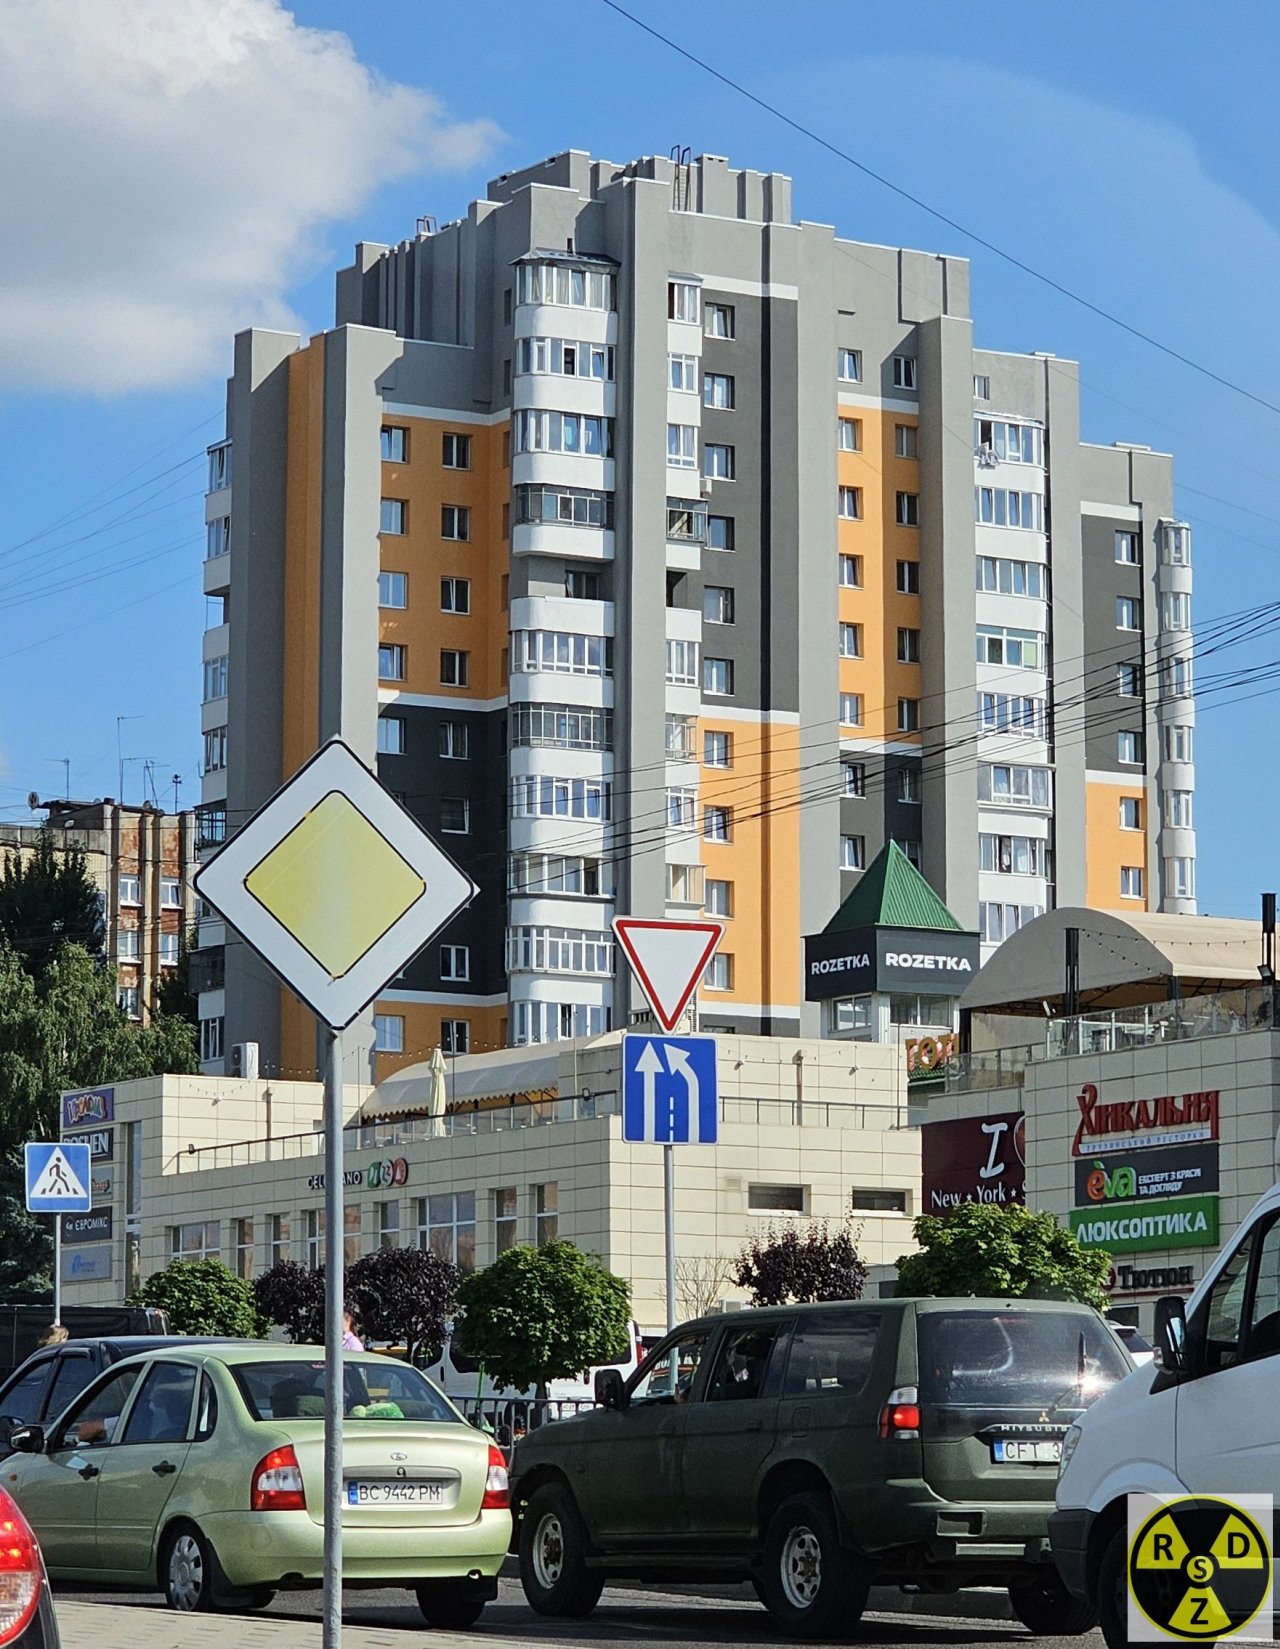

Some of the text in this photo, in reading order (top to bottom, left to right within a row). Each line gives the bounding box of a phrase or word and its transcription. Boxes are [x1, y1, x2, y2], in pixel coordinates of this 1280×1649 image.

[811, 953, 870, 975] ROZETKA
[885, 952, 972, 971] ROZETKA
[980, 1122, 1008, 1178] I
[1138, 1172, 1169, 1184] ЕКСПЕРТ
[1176, 1168, 1202, 1180] КРАСИ
[931, 1189, 962, 1209] New
[976, 1181, 1007, 1204] York
[1138, 1185, 1149, 1196] ТА
[1076, 1211, 1208, 1243] ЛЮКСОПТИКА
[1005, 1442, 1040, 1459] CFT
[360, 1485, 440, 1501] BC 9442 PM
